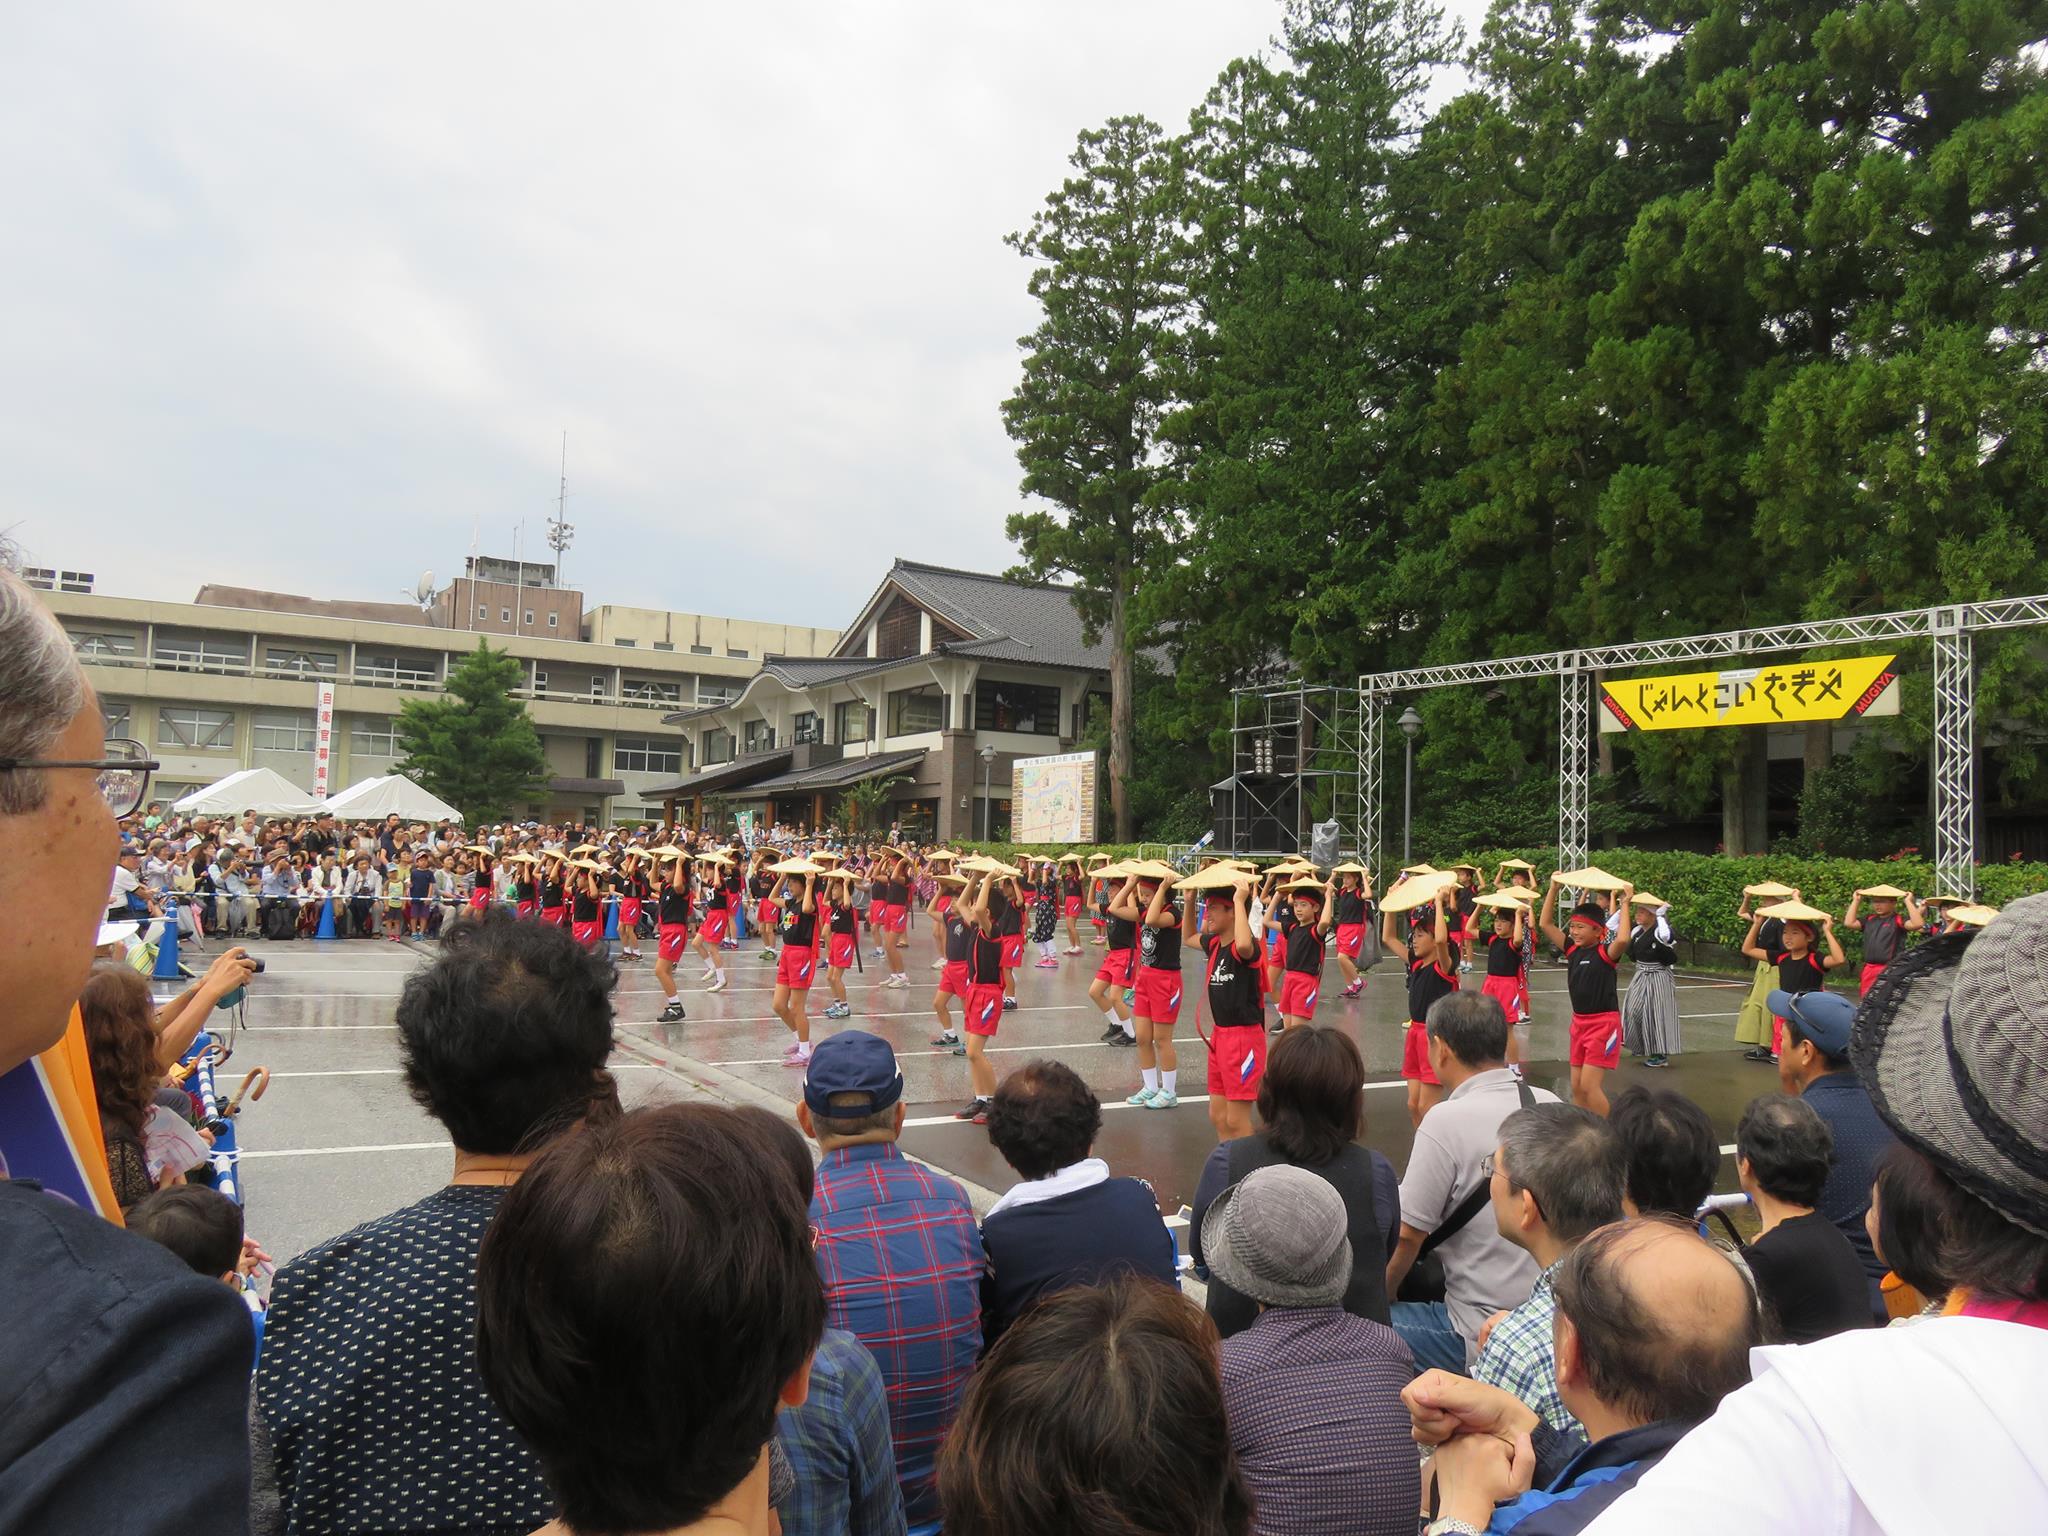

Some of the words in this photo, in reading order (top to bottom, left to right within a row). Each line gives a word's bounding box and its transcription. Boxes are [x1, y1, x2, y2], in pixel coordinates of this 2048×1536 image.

[1639, 667, 1843, 722] じゃんとこいむぎや
[1855, 672, 1896, 714] MUGIYA
[316, 692, 332, 798] 自衛官募集中
